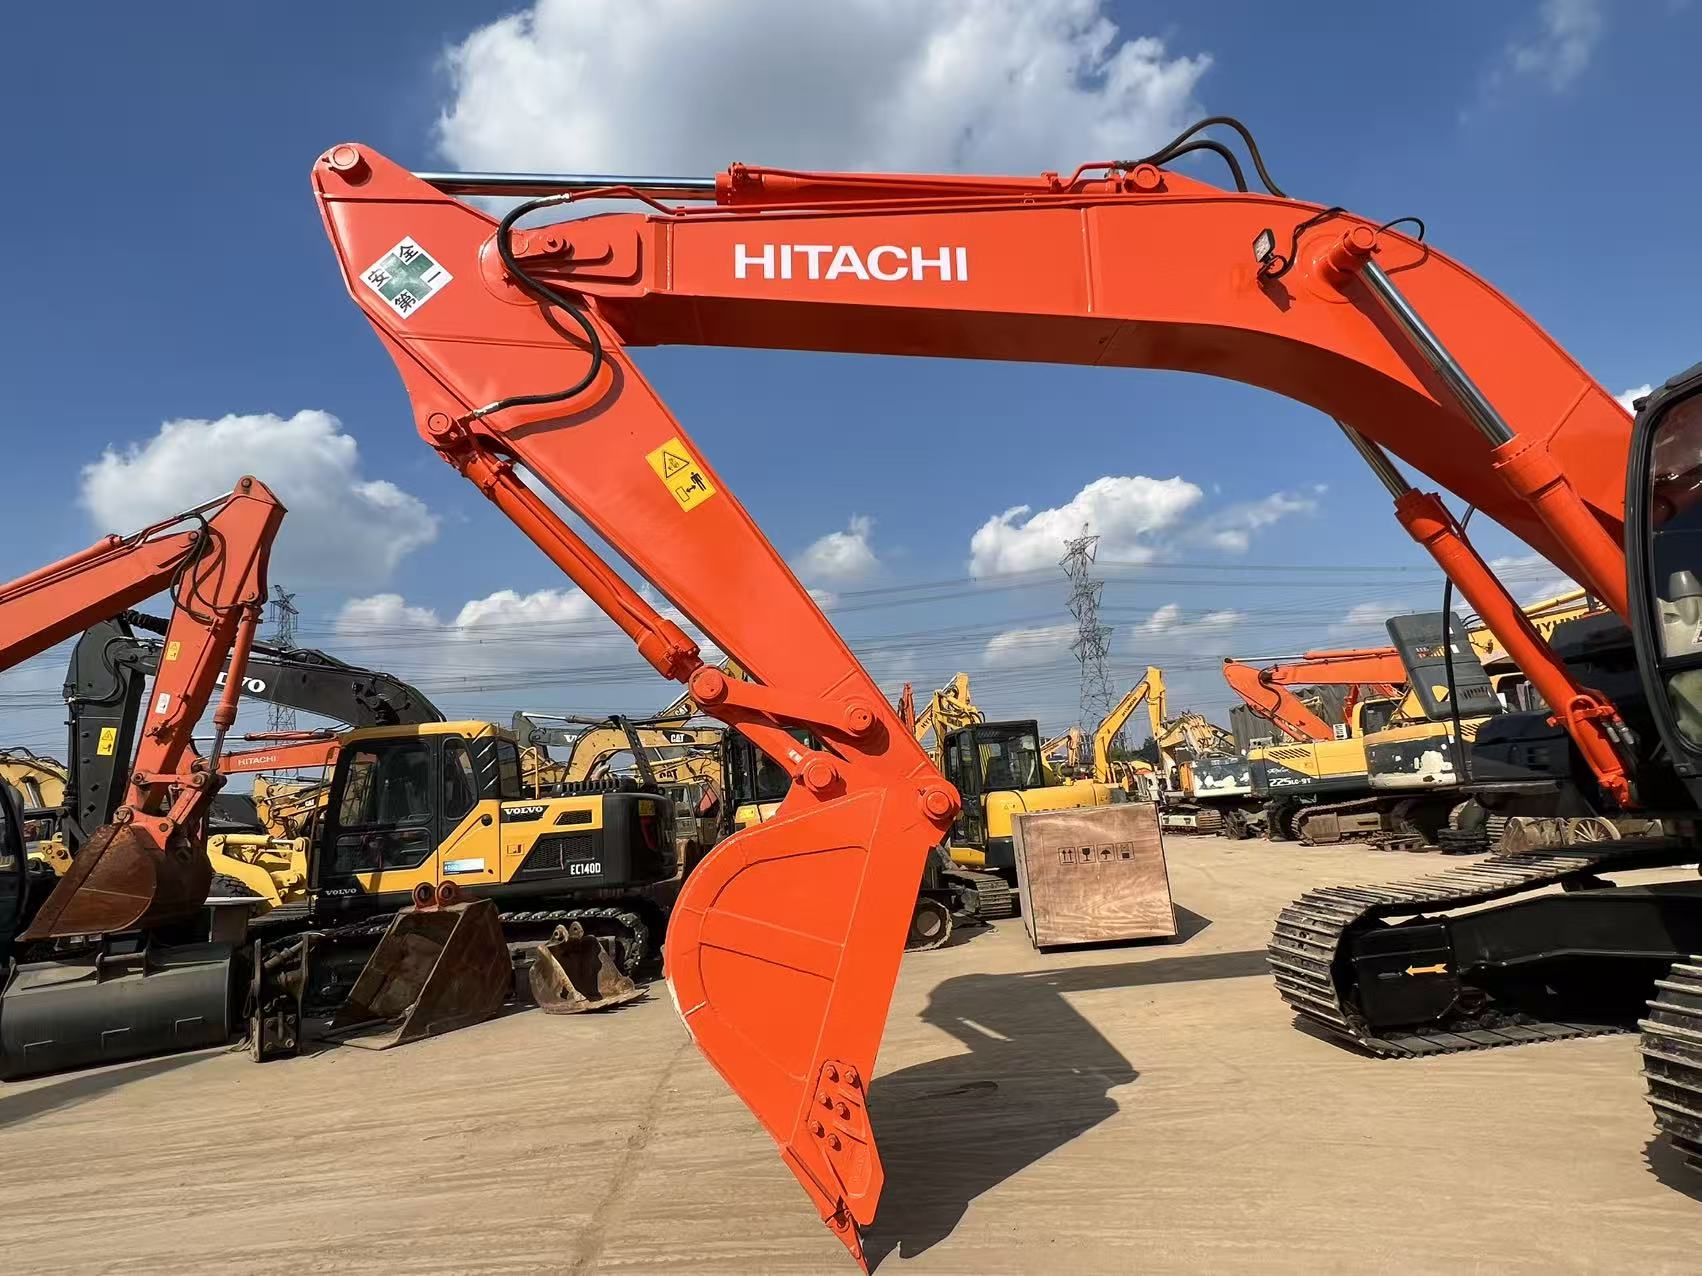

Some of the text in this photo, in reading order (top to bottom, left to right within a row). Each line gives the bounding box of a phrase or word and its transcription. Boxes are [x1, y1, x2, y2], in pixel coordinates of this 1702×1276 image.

[734, 243, 968, 282] HITACHI
[674, 704, 688, 716] CAT
[670, 733, 684, 743] CAT
[238, 756, 276, 766] HITACHI
[659, 769, 678, 780] CAT
[504, 806, 543, 815] VOLVO
[570, 862, 601, 875] EC140D
[325, 888, 357, 896] VOLVO
